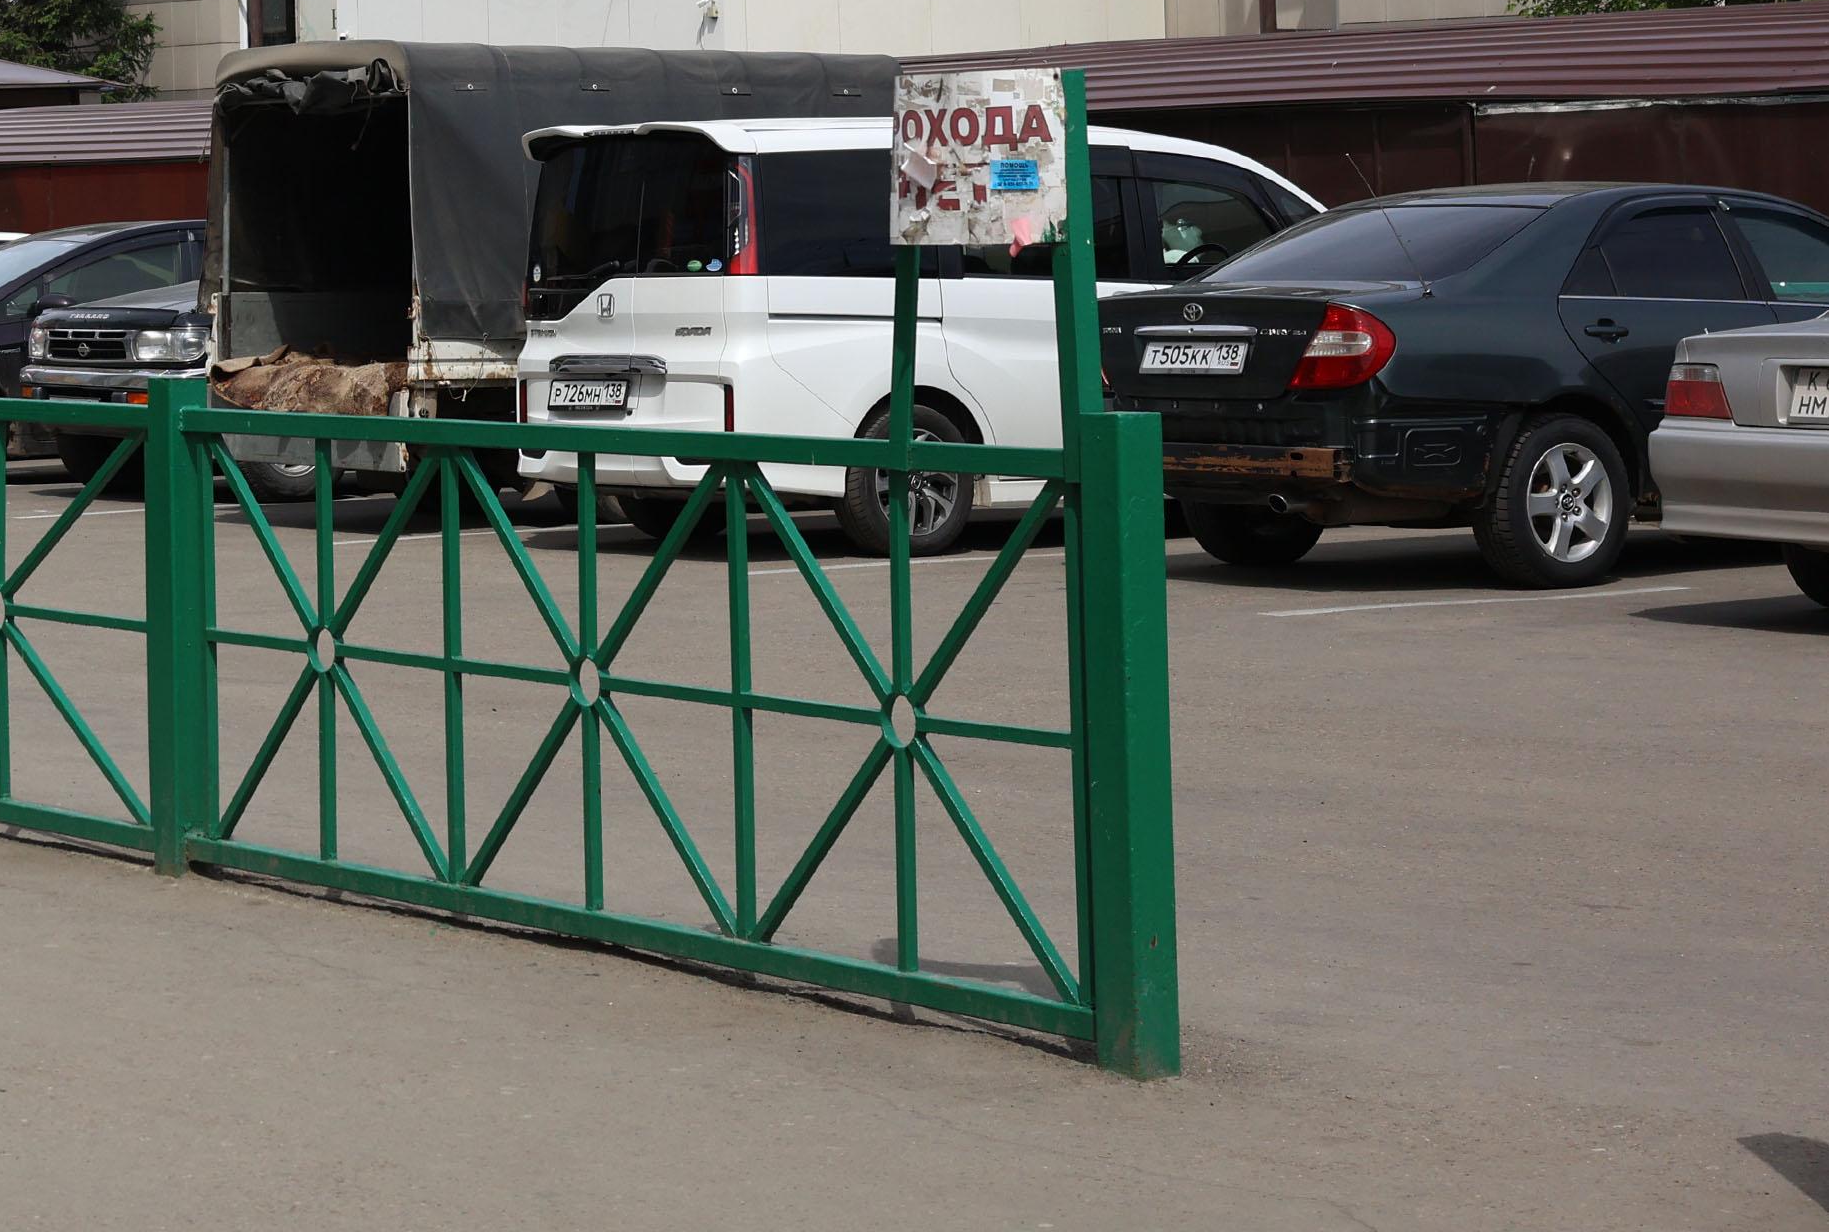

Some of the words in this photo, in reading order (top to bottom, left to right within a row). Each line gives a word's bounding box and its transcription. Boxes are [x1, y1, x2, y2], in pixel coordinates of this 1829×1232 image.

[1150, 345, 1212, 366] Т505КК
[1216, 345, 1240, 361] 138
[554, 383, 602, 403] Р726МН
[604, 383, 622, 398] 138
[1798, 396, 1827, 415] НМ
